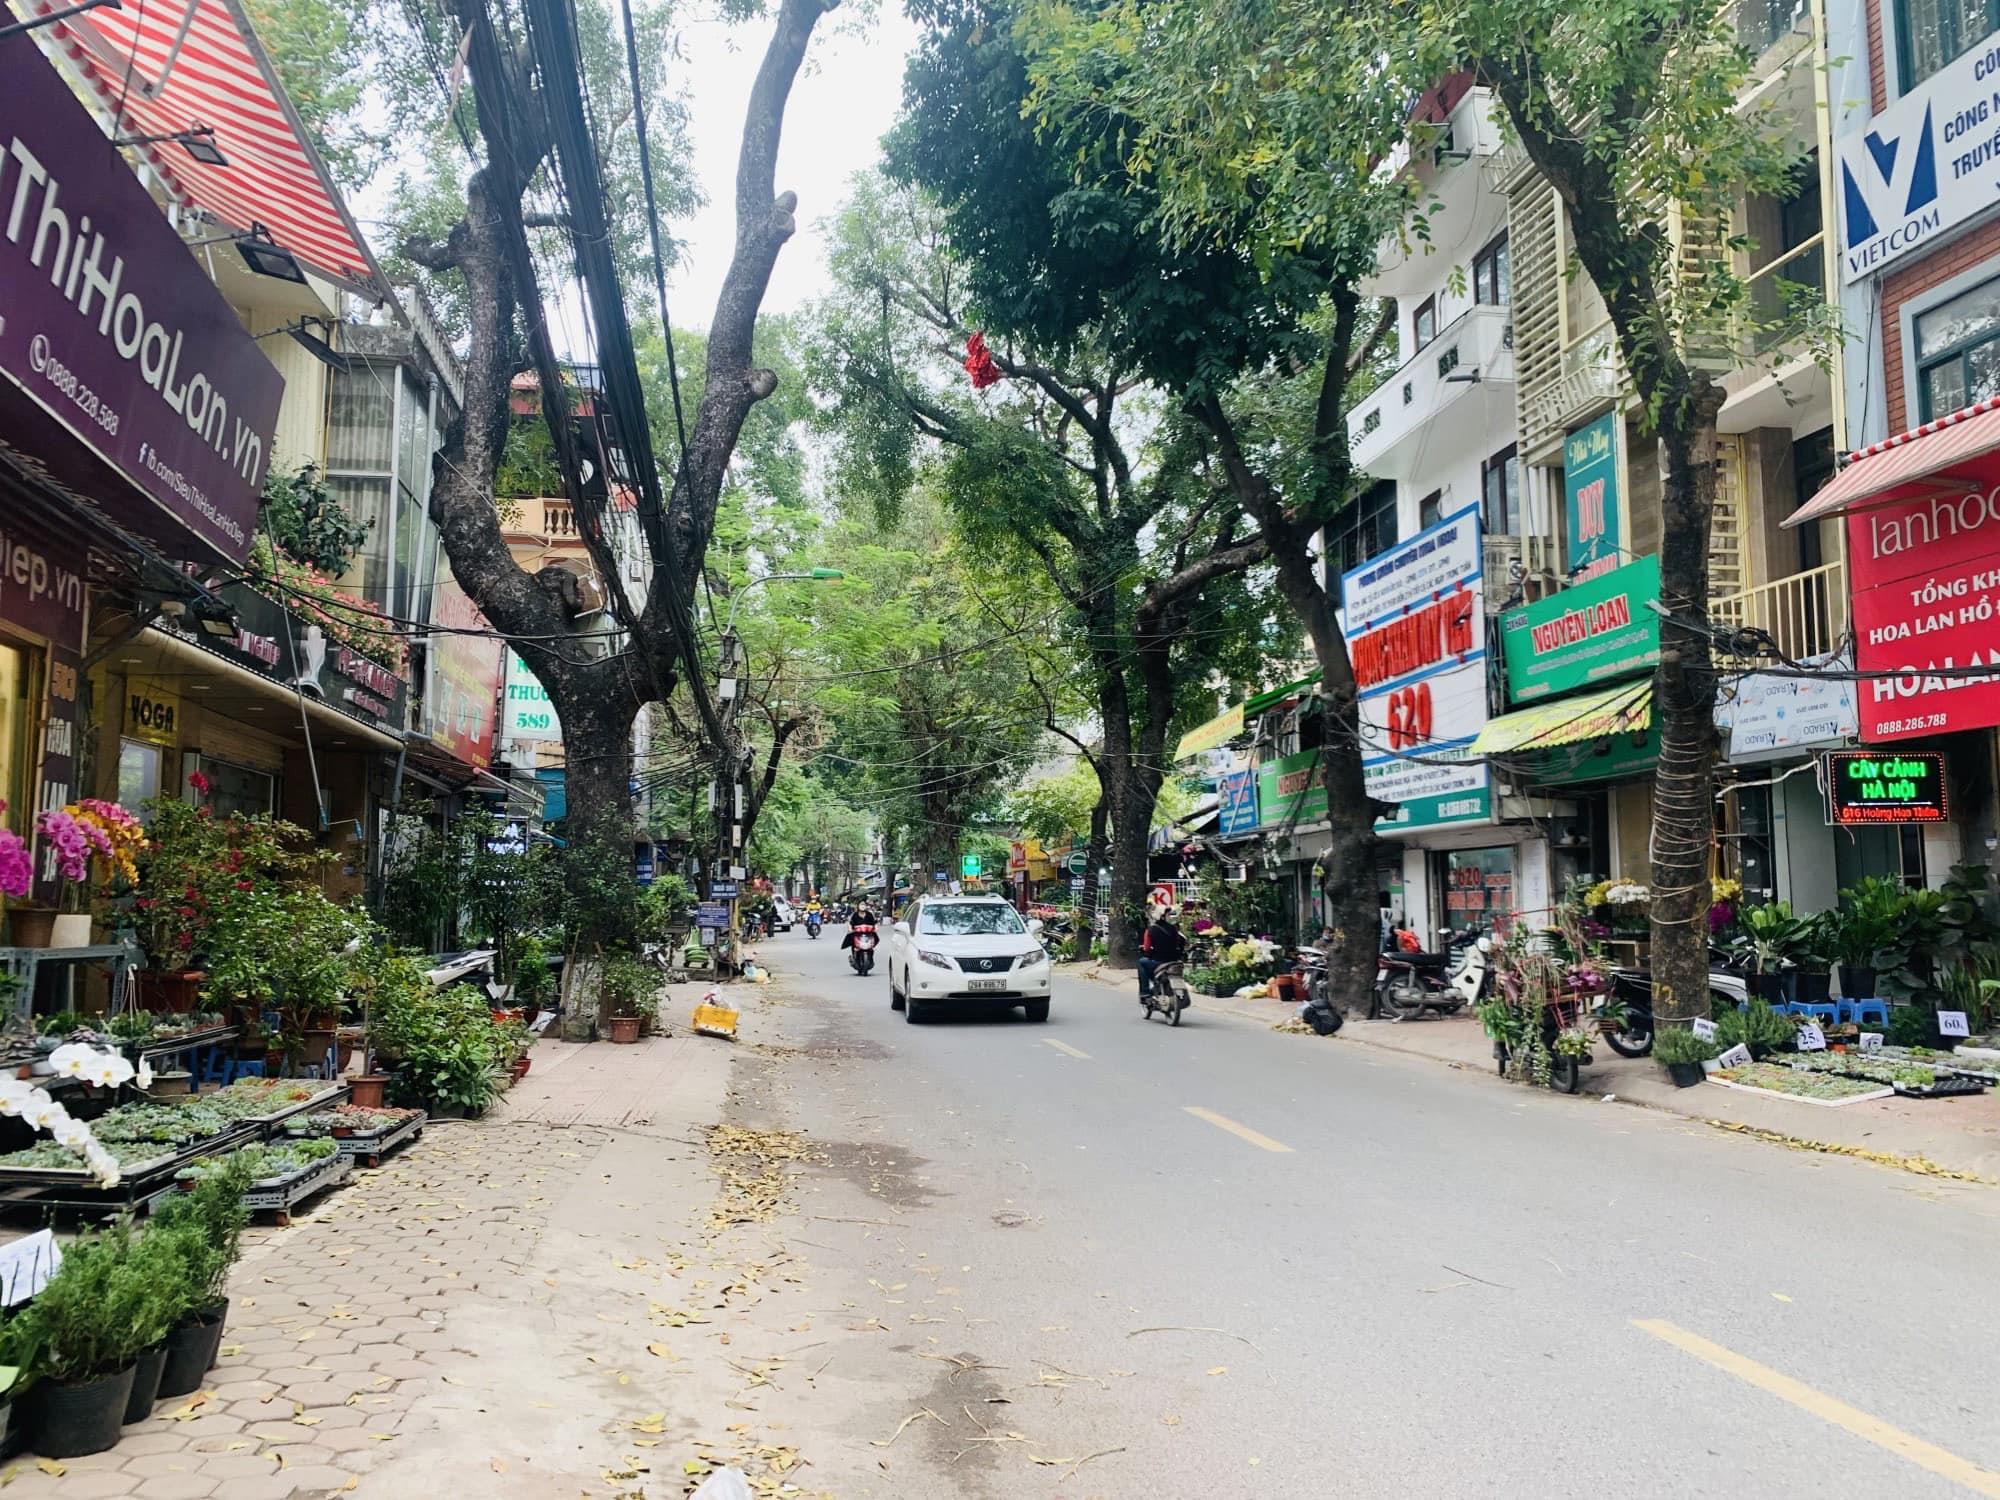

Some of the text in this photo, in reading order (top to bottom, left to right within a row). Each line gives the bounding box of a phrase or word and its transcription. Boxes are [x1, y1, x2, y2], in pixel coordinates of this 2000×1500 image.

[1944, 99, 1989, 144] CÔNG
[1849, 208, 1940, 273] VIETCOM
[47, 357, 119, 436] 0888.228.588
[1911, 577, 1967, 606] TỔNG
[1589, 592, 1631, 636] LOAN
[1869, 594, 1992, 645] HOA LAN HỒ
[131, 694, 174, 733] YOGA
[516, 712, 550, 729] 589
[1388, 682, 1432, 750] 620
[1877, 713, 1947, 735] 0888.286.788
[1849, 757, 1927, 778] CÂY CẢNH
[1861, 778, 1917, 802] HÀ NỘI
